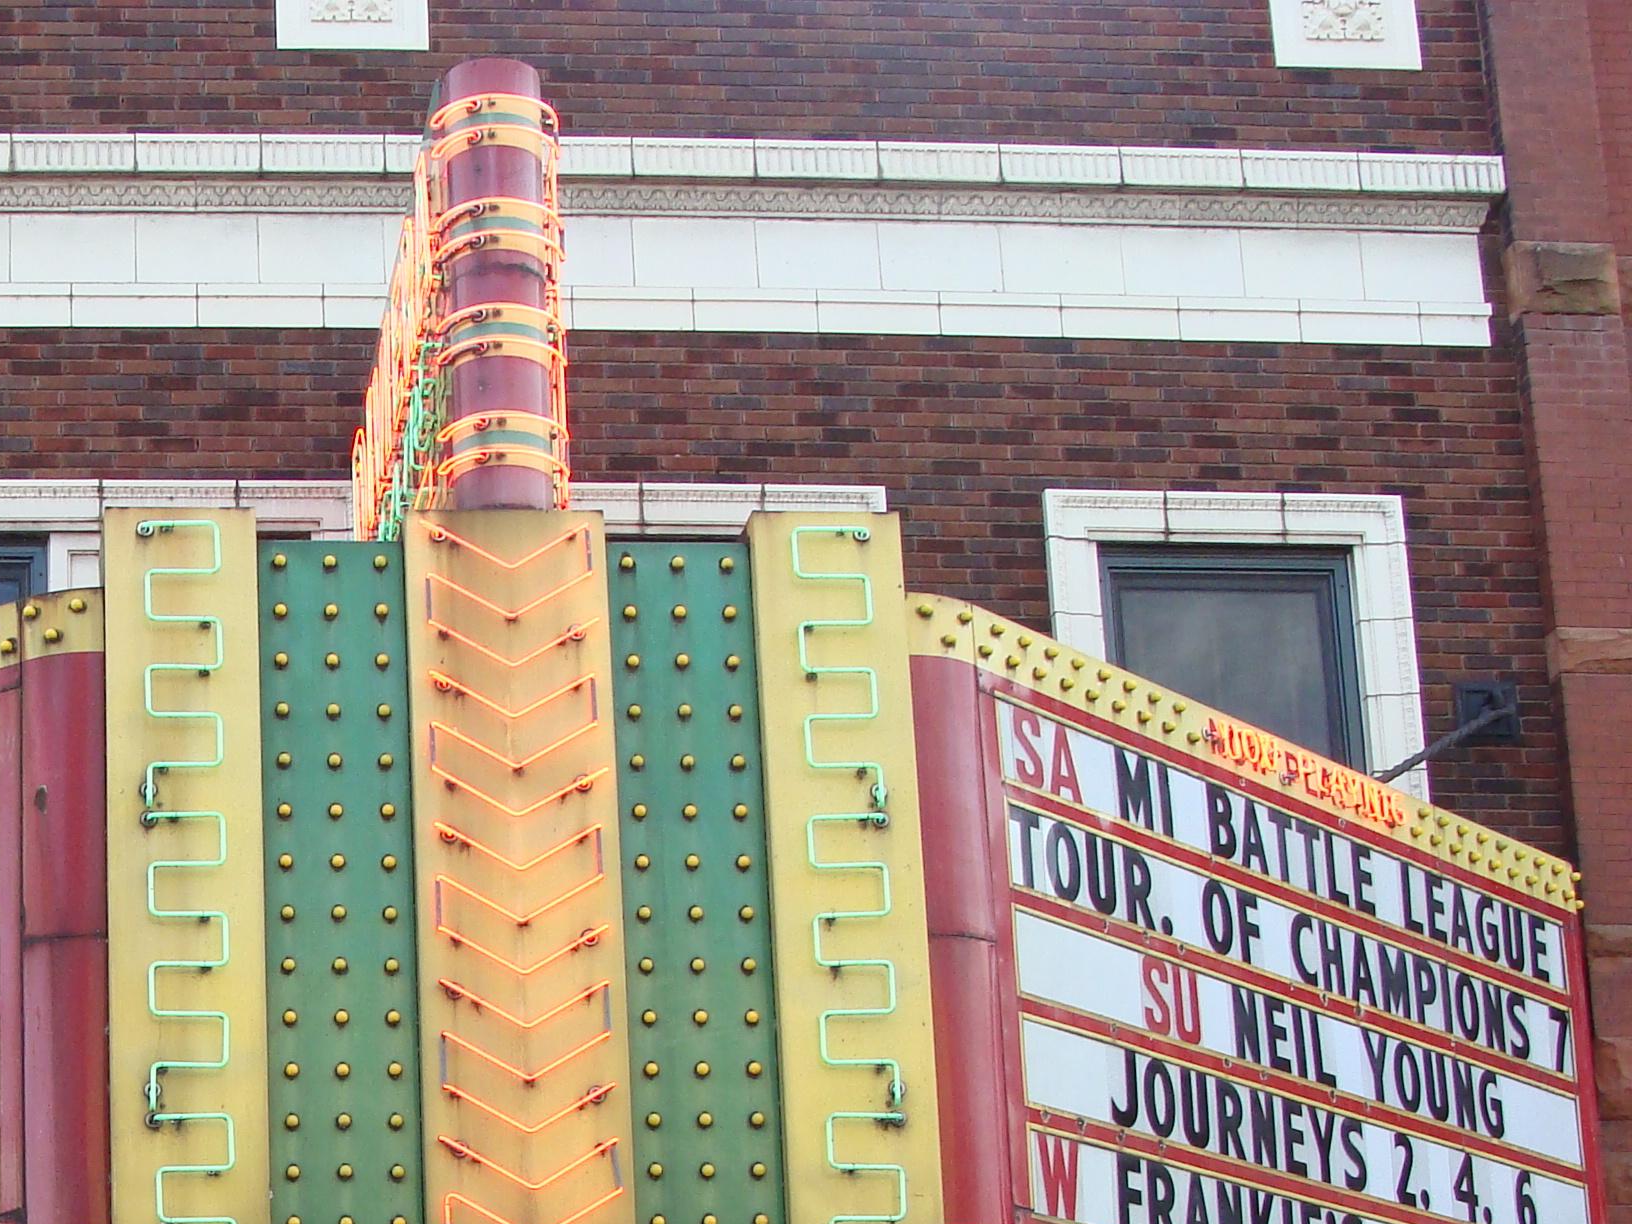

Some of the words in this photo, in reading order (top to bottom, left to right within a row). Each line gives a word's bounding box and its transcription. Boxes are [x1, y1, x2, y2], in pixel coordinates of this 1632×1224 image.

[1012, 708, 1083, 805] SA
[1115, 747, 1174, 839] MI
[1209, 784, 1376, 914] BATTLE
[1400, 842, 1549, 977] LEAGUE
[1010, 814, 1174, 935] TOUR.
[1202, 880, 1262, 963] OF
[1290, 914, 1531, 1061] CHAMPIONS
[1549, 1010, 1569, 1074] 7
[1110, 1057, 1367, 1192] JOURNEYS
[1142, 956, 1201, 1045] SU
[1234, 987, 1336, 1087] NEIL
[1362, 1032, 1503, 1140] YOUNG
[1039, 1134, 1079, 1222] W
